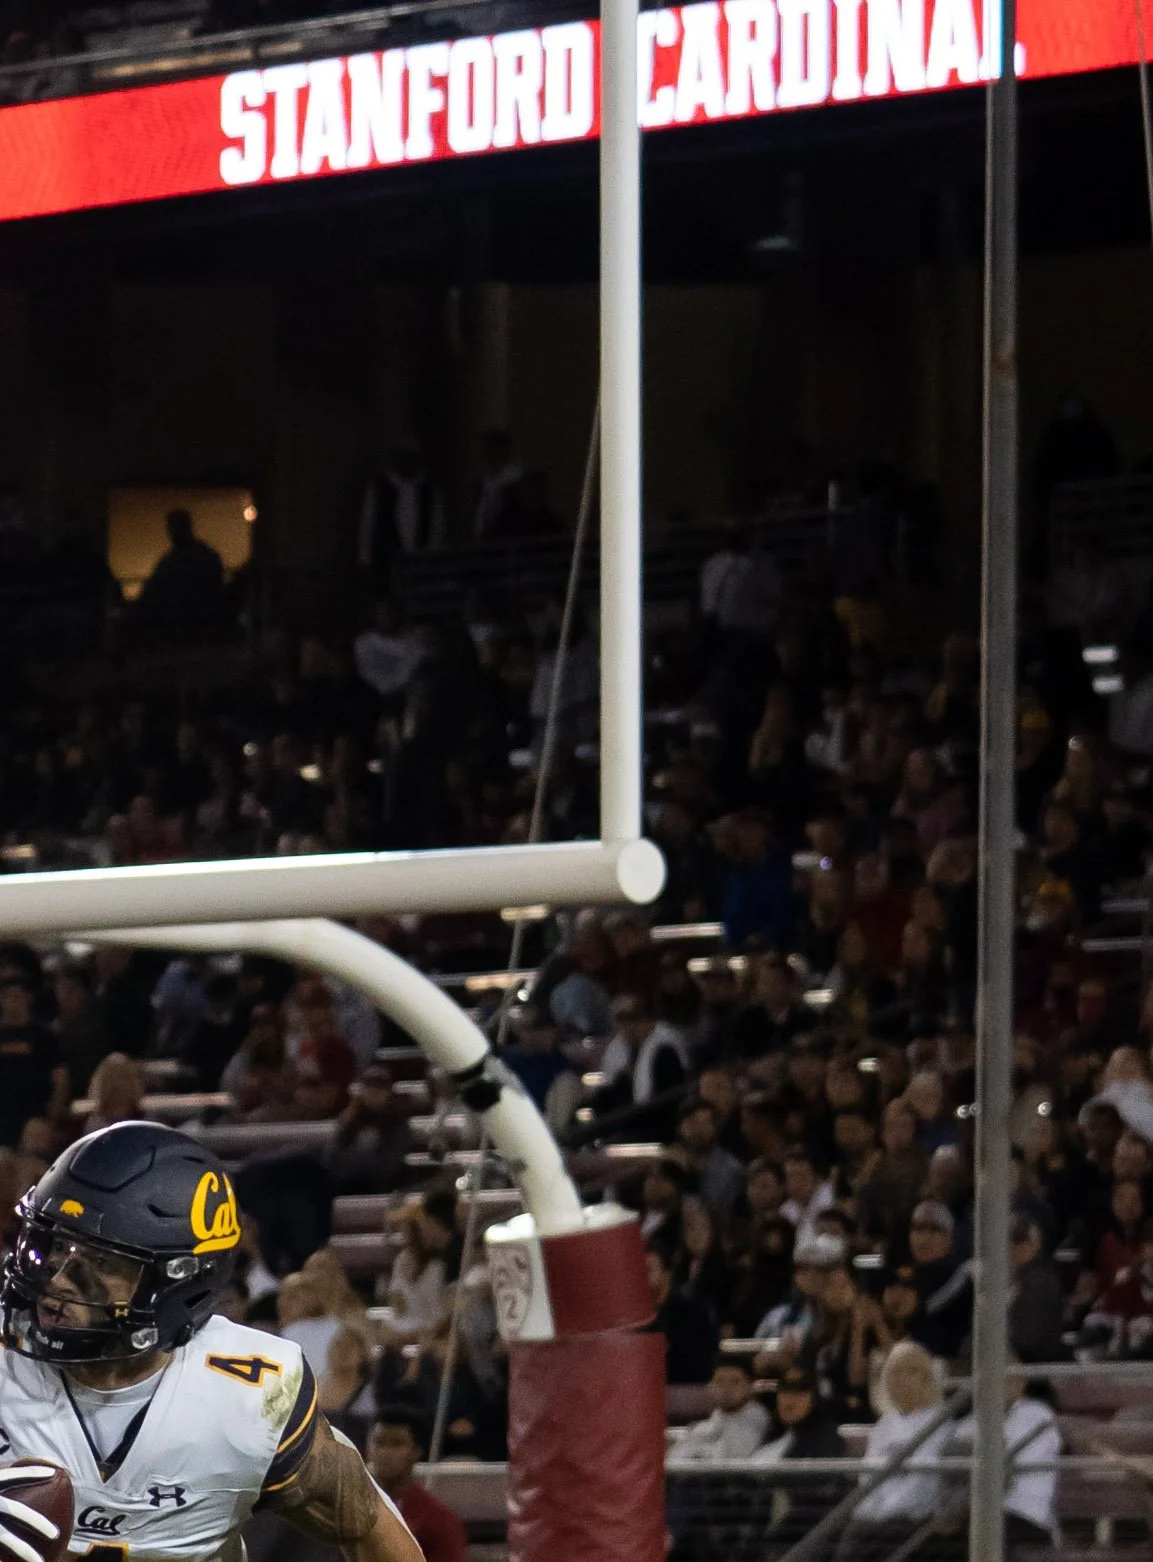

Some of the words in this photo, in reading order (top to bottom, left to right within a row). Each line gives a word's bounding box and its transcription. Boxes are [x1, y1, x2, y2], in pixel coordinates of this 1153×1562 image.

[219, 21, 594, 185] STANFORD
[191, 1171, 241, 1255] Cal
[205, 1353, 282, 1387] 4
[74, 1505, 127, 1536] Cal
